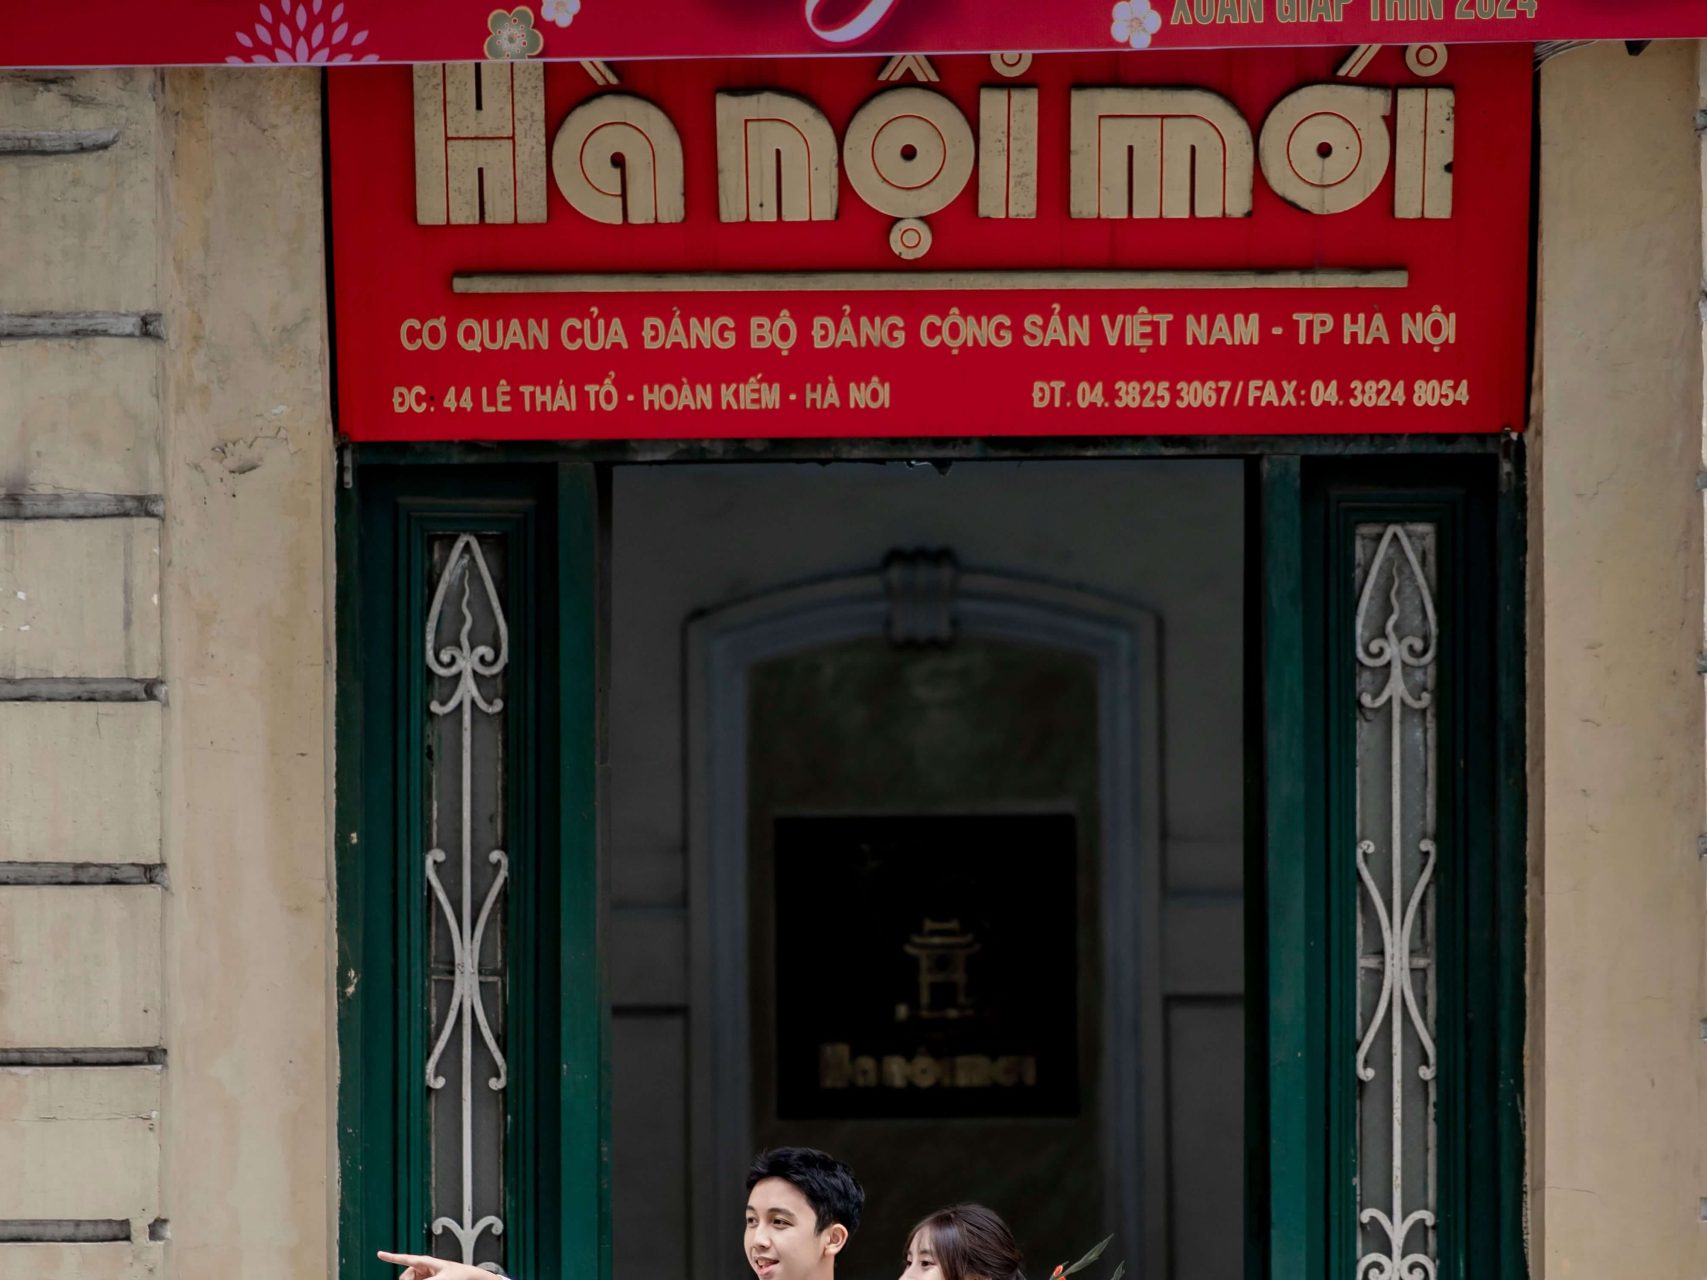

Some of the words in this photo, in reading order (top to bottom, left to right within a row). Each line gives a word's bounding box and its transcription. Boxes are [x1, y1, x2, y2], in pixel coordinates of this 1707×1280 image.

[400, 316, 447, 350] CƠ
[457, 318, 549, 352] QUAN
[560, 306, 629, 350] CỦA
[642, 306, 736, 349] ĐẢNG
[750, 309, 798, 356] BỘ
[811, 305, 905, 348] ĐẢNG
[920, 307, 1012, 355] CỘNG
[1023, 303, 1090, 347] SẢN
[1101, 306, 1173, 353] VIỆT
[1186, 313, 1259, 345] NAM
[1292, 313, 1334, 345] TP
[1343, 304, 1390, 345] HÀ
[1401, 305, 1456, 353] NỘI
[443, 386, 473, 412] 44
[482, 379, 512, 413] LÊ
[519, 378, 576, 412] THÁI
[584, 370, 619, 411] TỔ
[642, 377, 712, 410] HOÀN
[720, 373, 780, 410] KIẾM
[805, 375, 841, 409] HÀ
[1114, 381, 1170, 408] 3825
[1349, 379, 1406, 407] 3824
[1412, 378, 1469, 406] 8054
